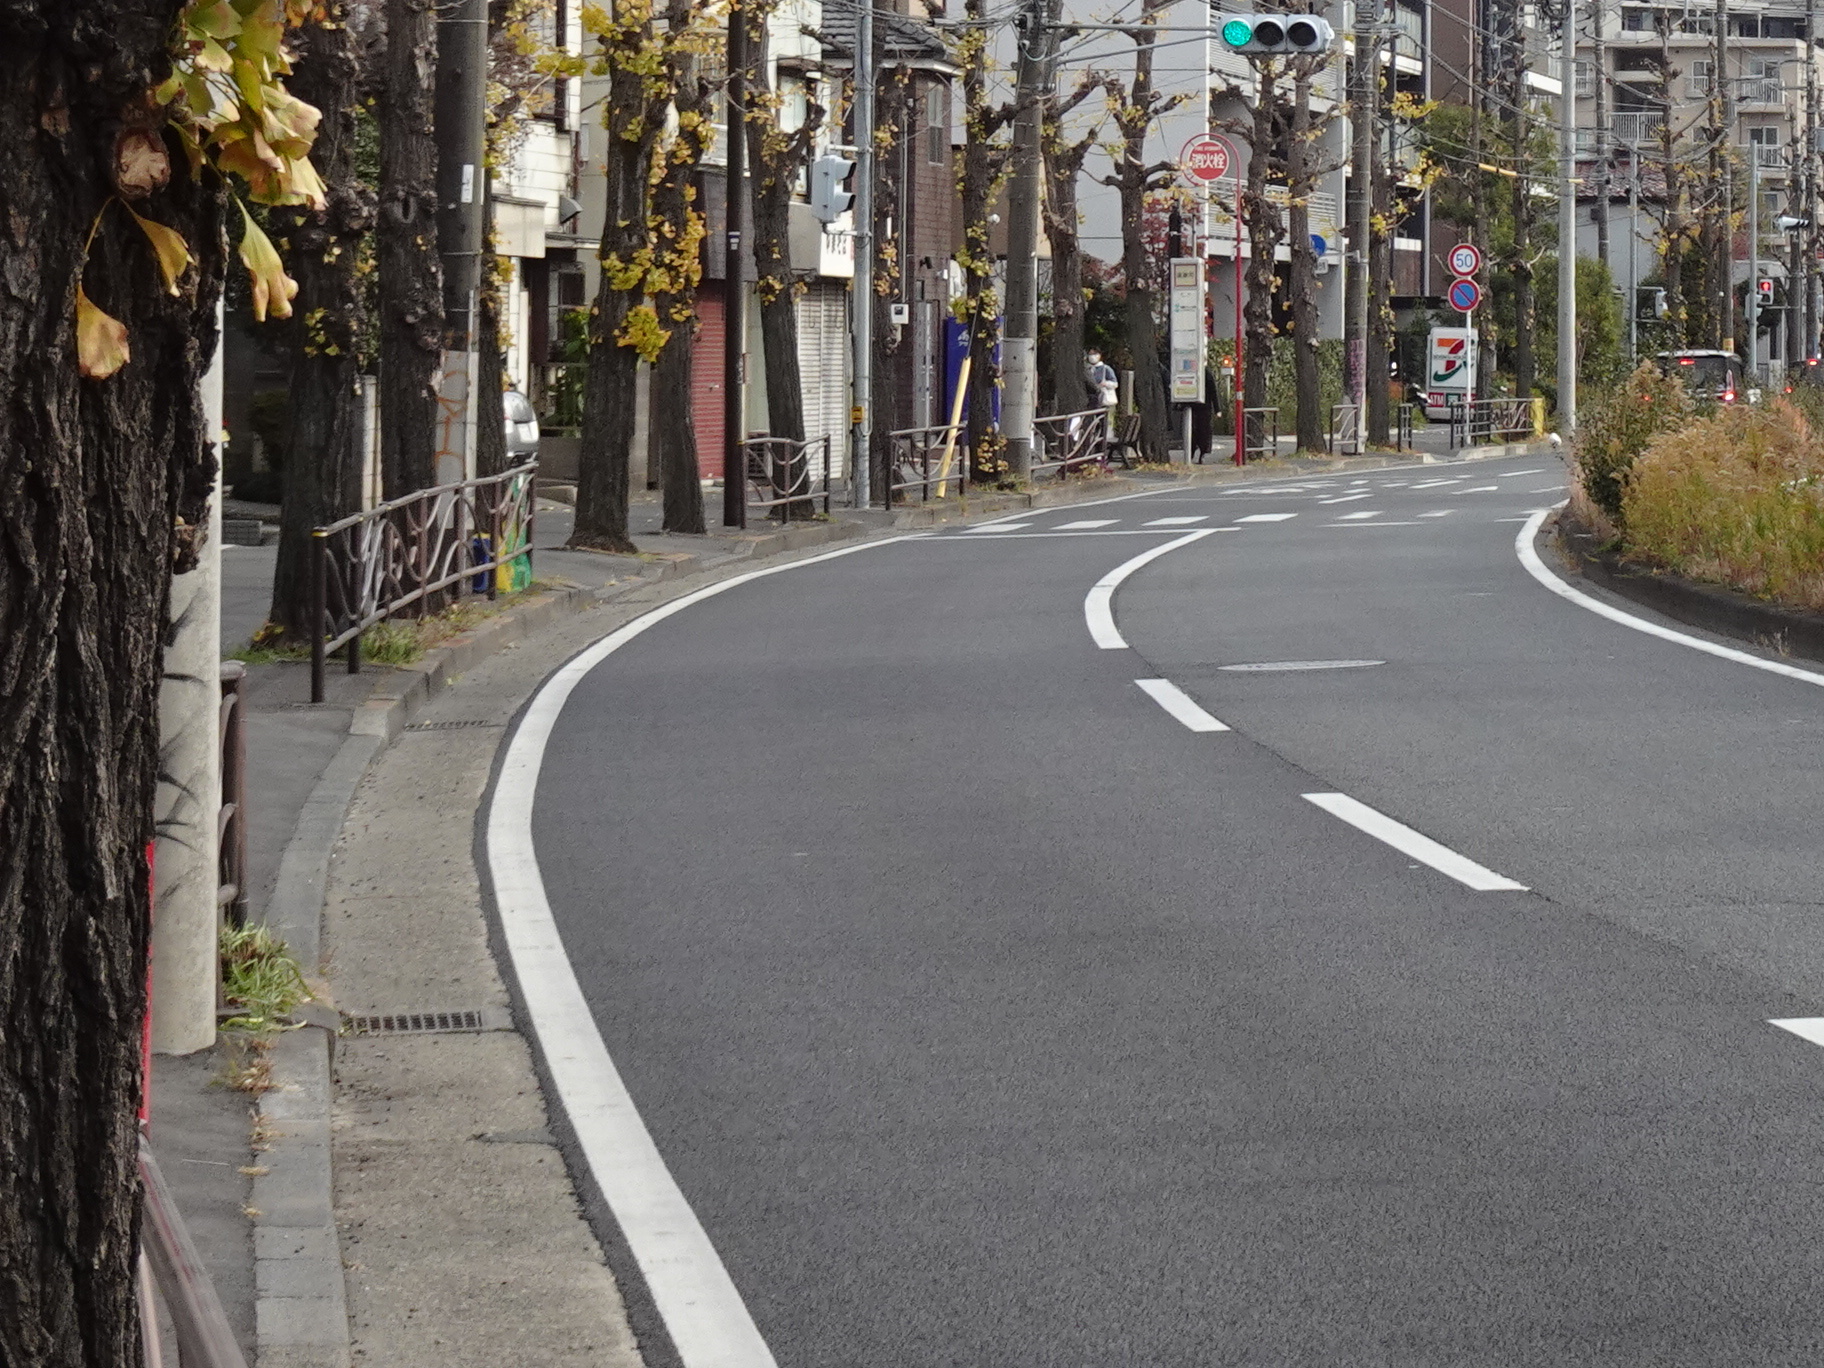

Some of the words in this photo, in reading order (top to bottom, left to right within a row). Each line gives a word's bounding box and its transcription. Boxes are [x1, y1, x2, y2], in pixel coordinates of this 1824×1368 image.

[1192, 153, 1226, 169] 消火栓
[1456, 253, 1473, 268] 50
[1429, 394, 1444, 405] ATM
